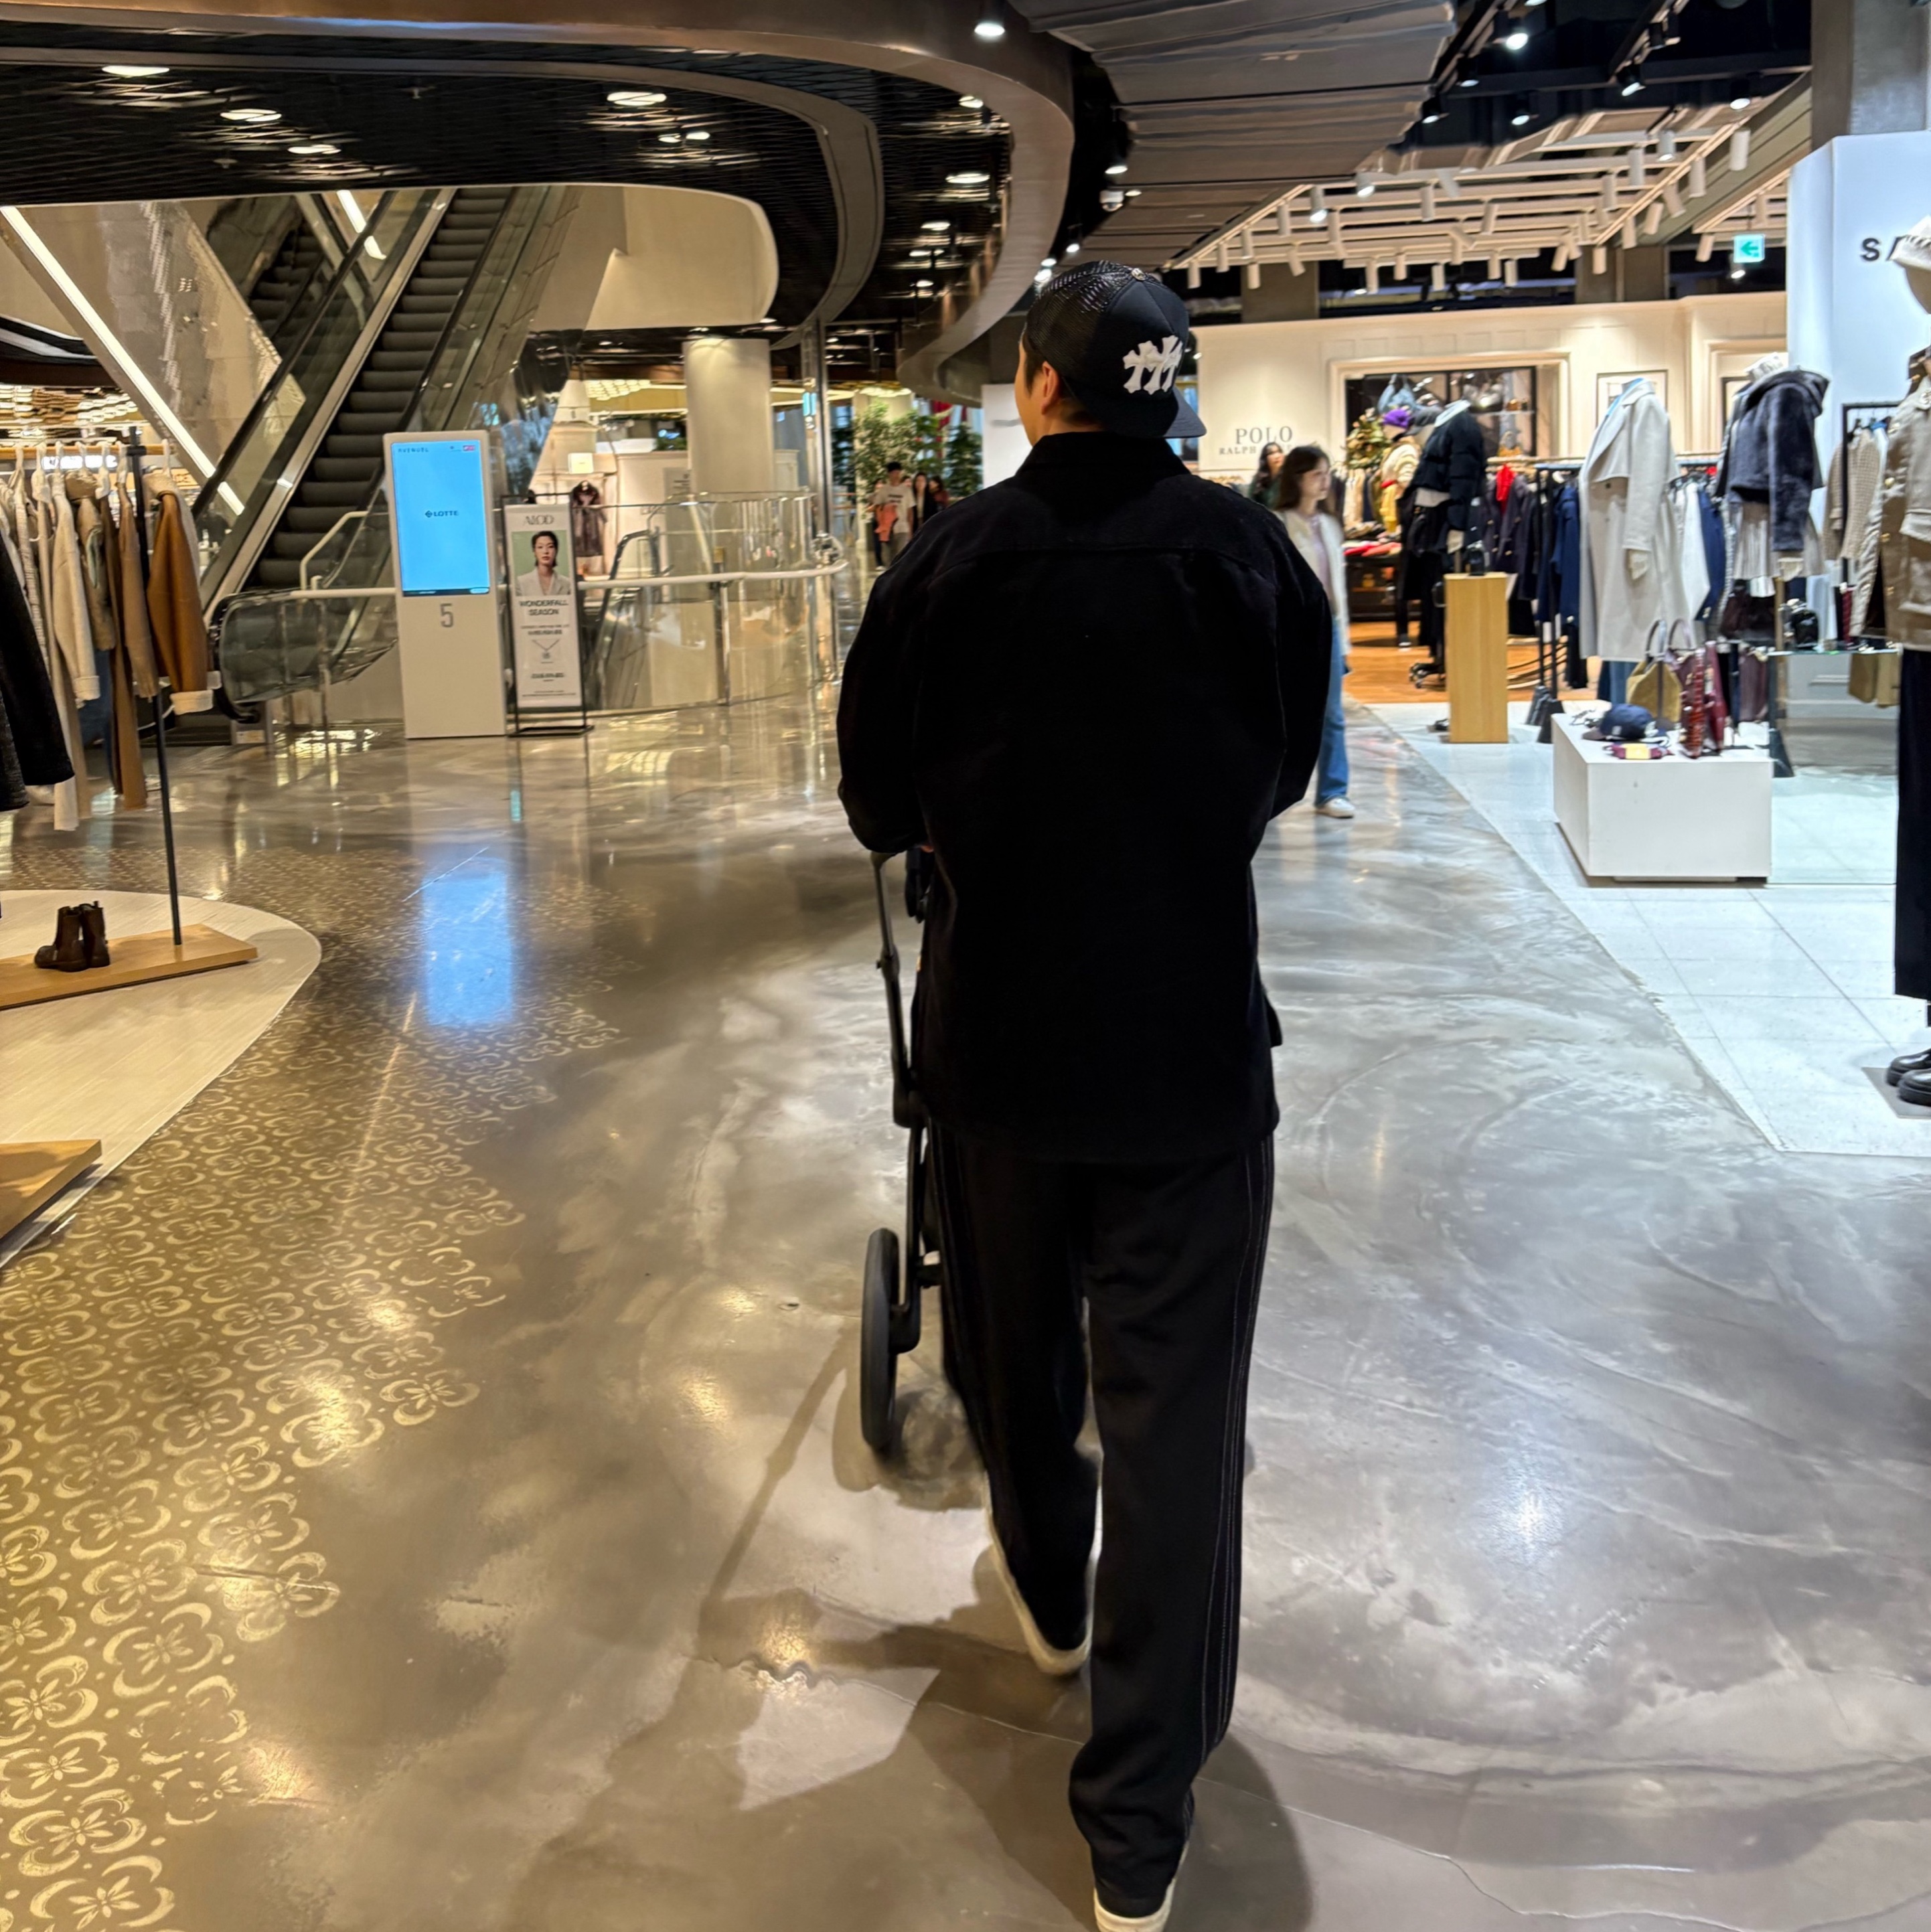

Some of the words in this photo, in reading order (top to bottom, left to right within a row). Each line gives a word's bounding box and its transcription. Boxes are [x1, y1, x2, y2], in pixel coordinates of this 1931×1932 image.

[1235, 426, 1292, 445] POLO
[1219, 446, 1256, 455] RALPH
[440, 603, 453, 628] 5
